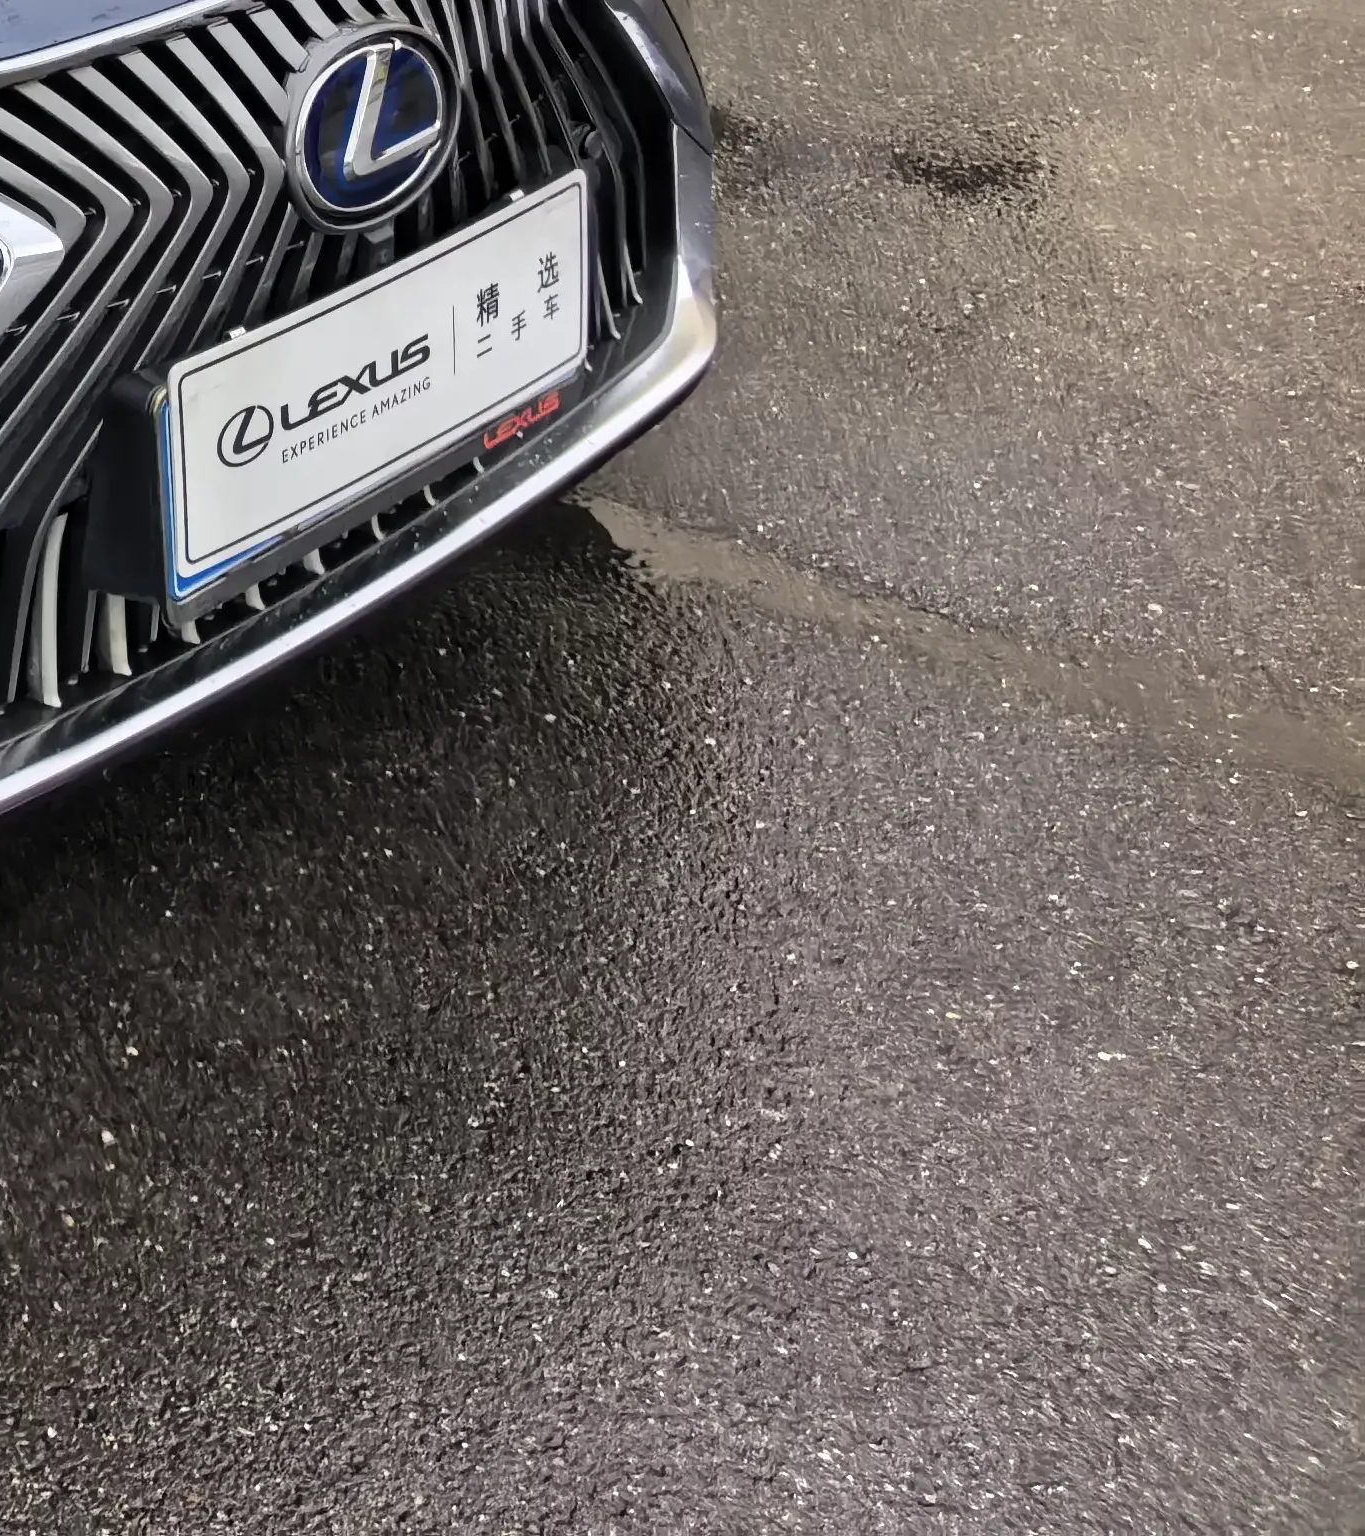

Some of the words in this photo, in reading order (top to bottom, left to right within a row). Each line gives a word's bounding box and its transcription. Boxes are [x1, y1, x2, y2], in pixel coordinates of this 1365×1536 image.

[280, 332, 432, 432] LEXUS
[281, 408, 368, 465] EXPERIENCE
[371, 375, 432, 419] AMAZING
[483, 390, 562, 450] LEXUS
